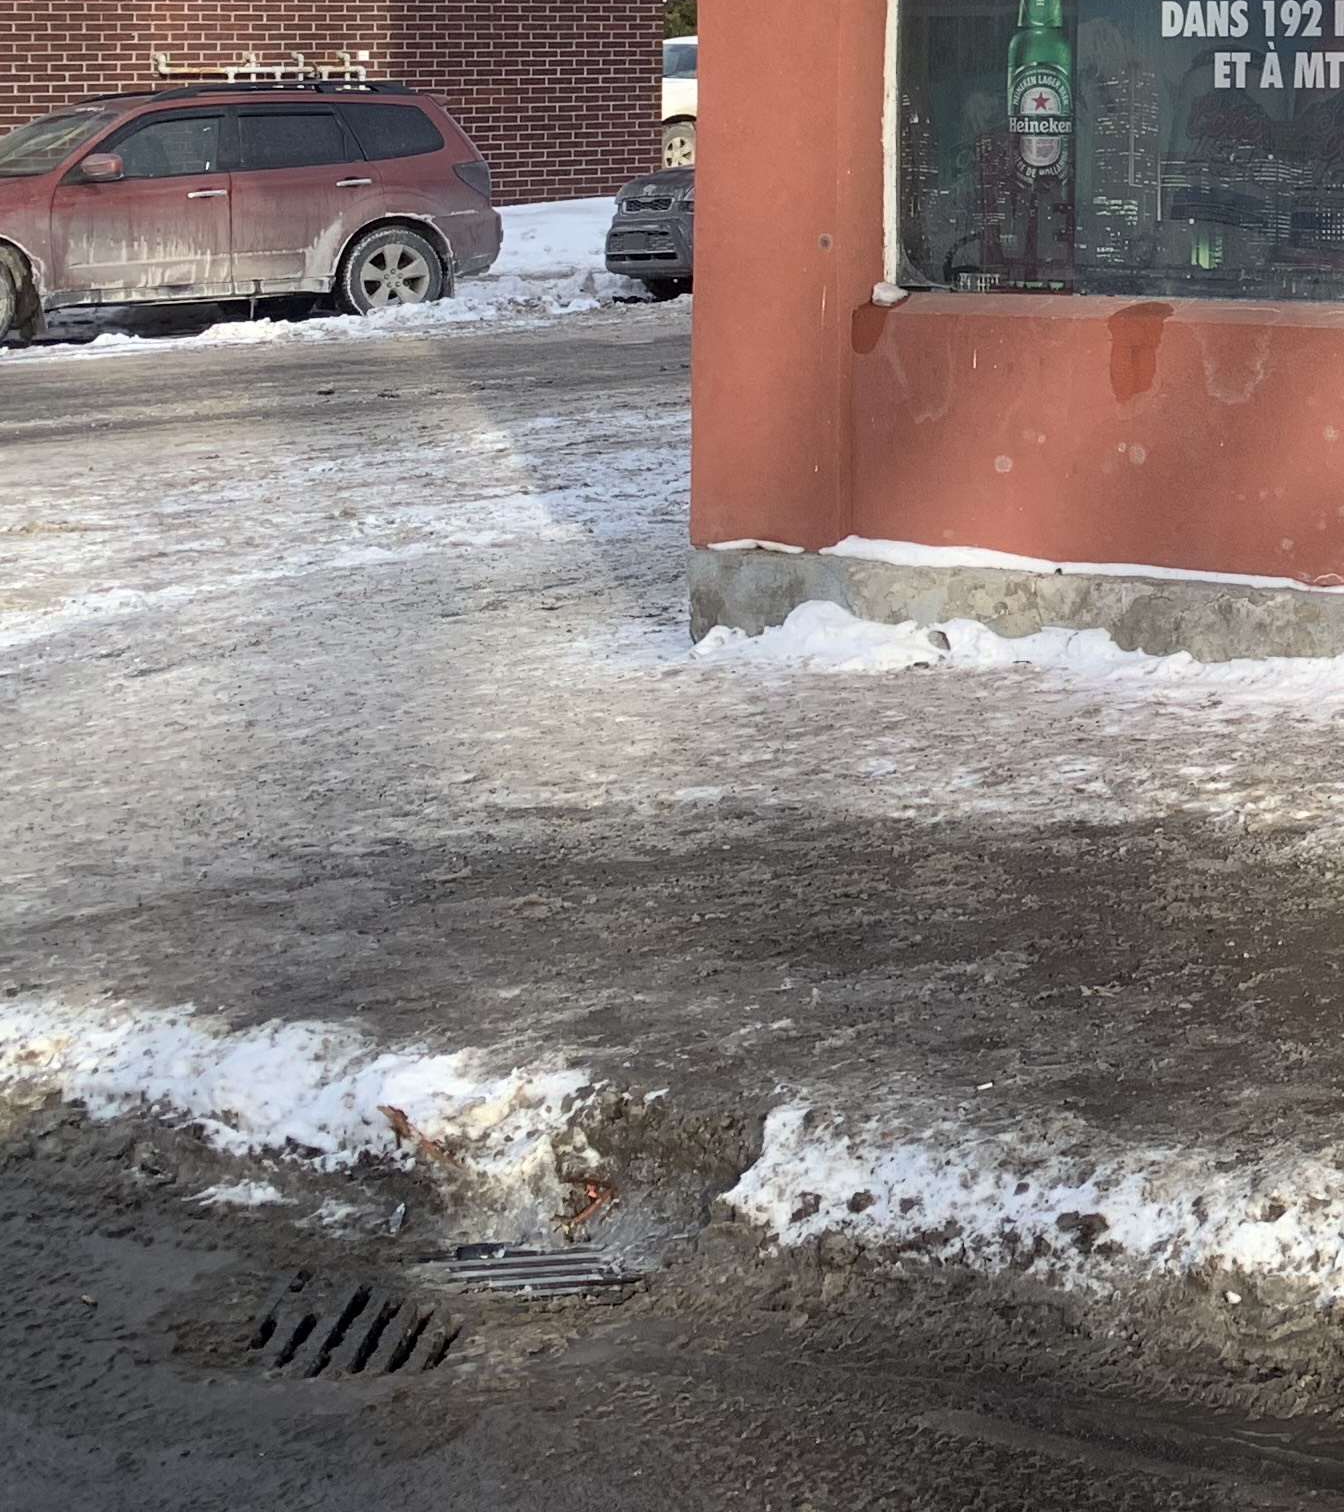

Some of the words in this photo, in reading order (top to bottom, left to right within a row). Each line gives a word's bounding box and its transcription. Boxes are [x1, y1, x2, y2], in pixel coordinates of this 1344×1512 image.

[1160, 0, 1250, 38] DANS
[1262, 0, 1323, 37] 192
[1214, 51, 1252, 89] ET
[1259, 40, 1284, 89] À
[1008, 117, 1073, 134] Heineken
